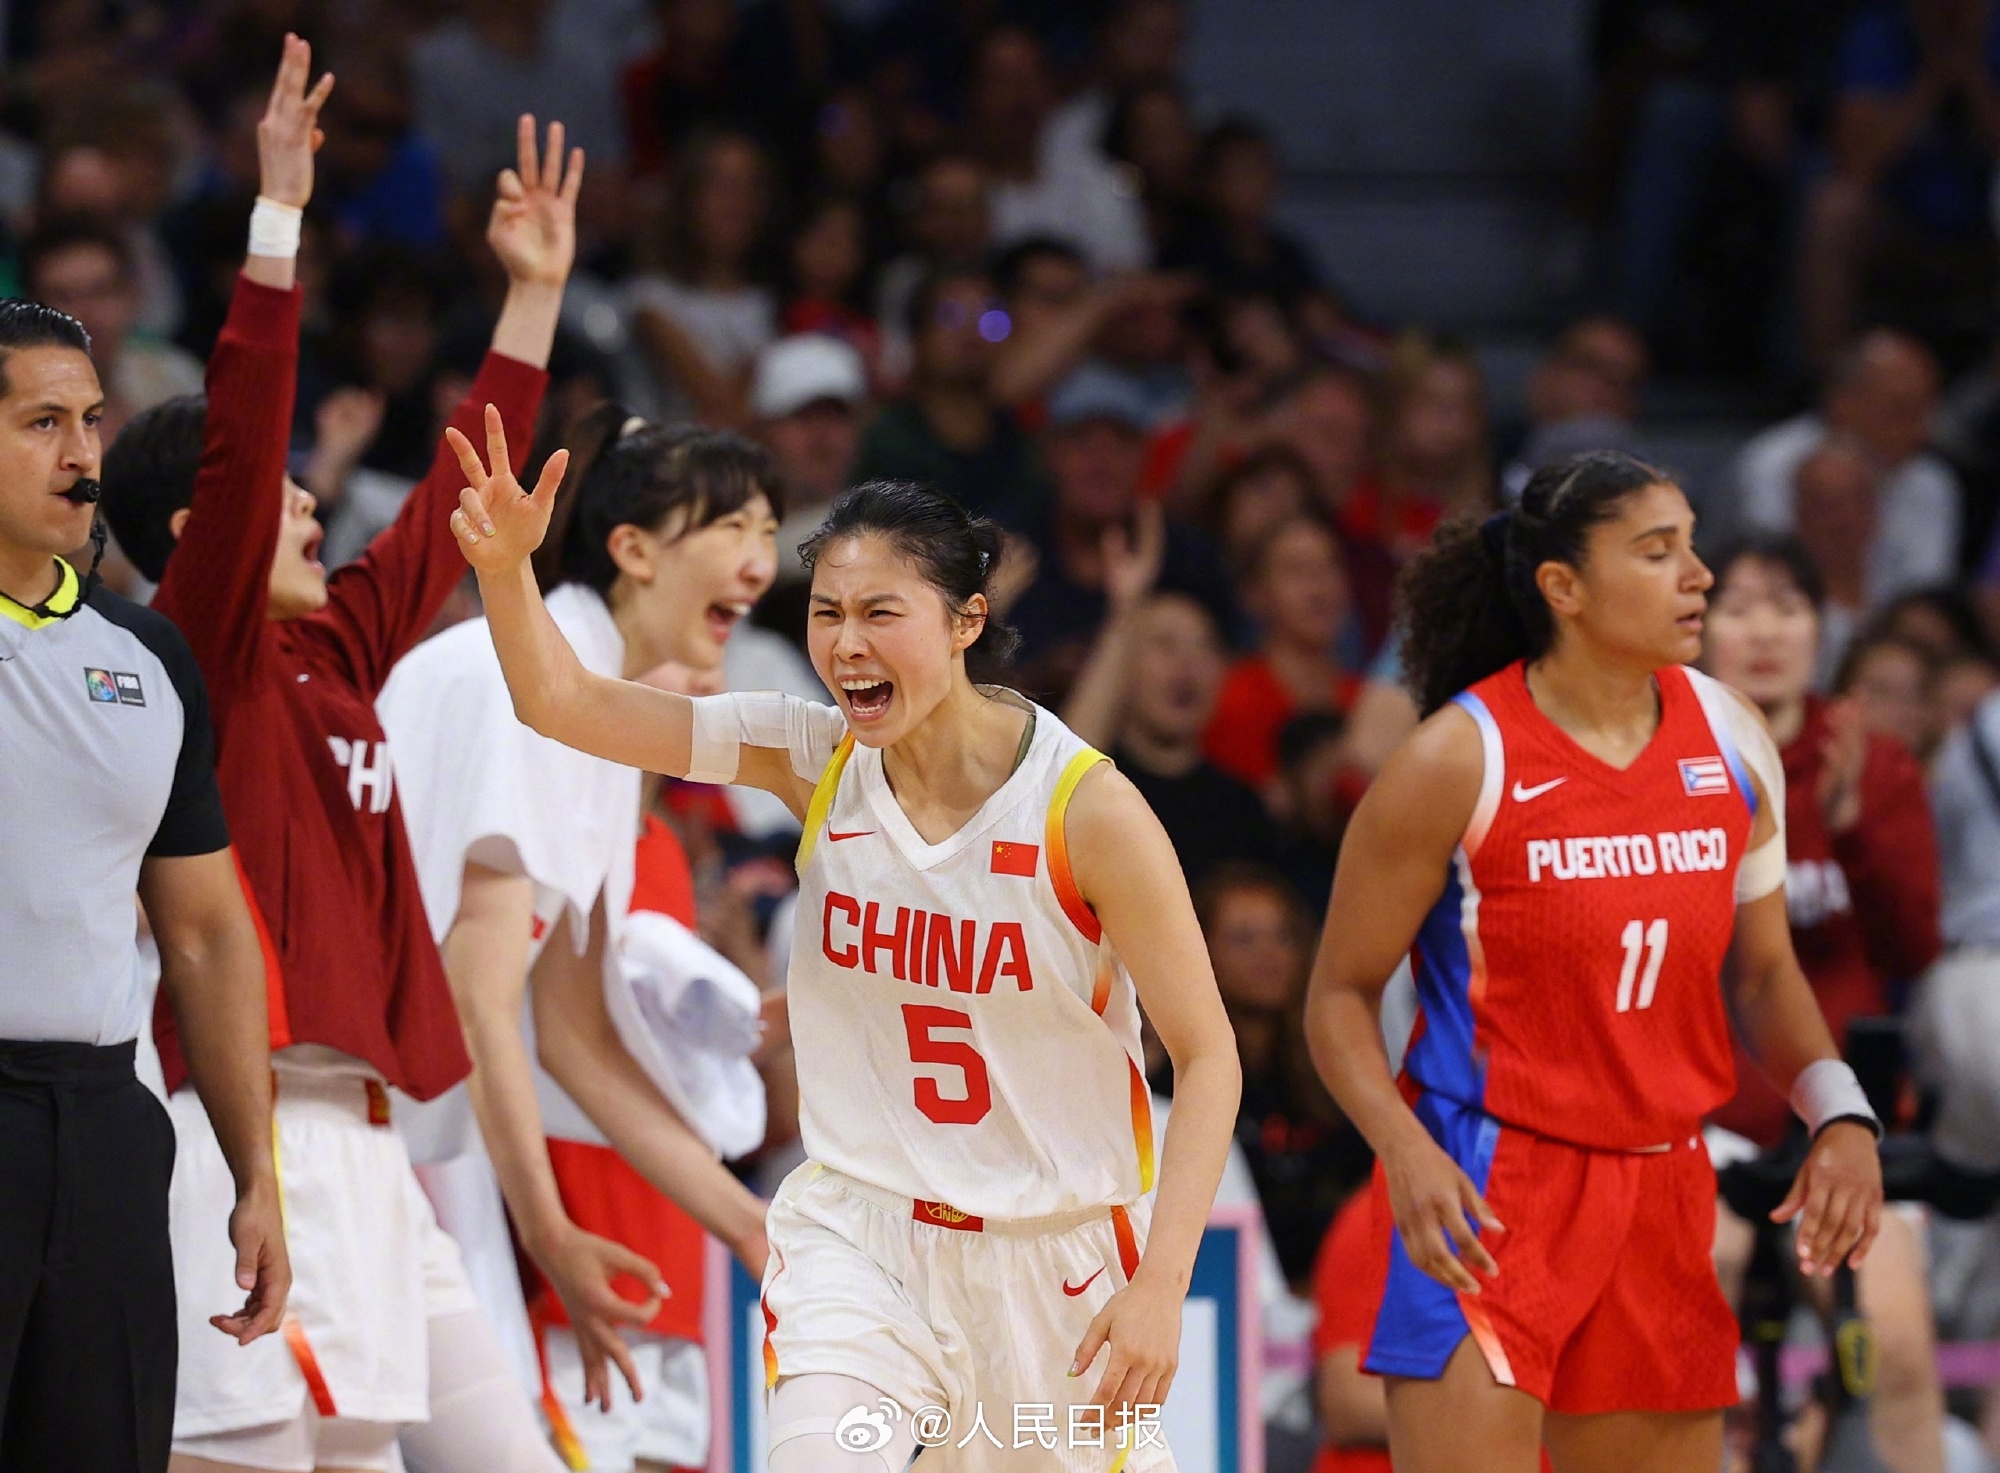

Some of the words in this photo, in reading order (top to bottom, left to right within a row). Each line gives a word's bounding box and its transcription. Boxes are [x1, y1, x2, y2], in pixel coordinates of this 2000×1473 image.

[1526, 834, 1656, 883] PUERTO
[1657, 827, 1727, 874] RICO
[822, 890, 1033, 994] CHINA
[1615, 918, 1669, 1013] 11
[901, 1003, 991, 1125] 5
